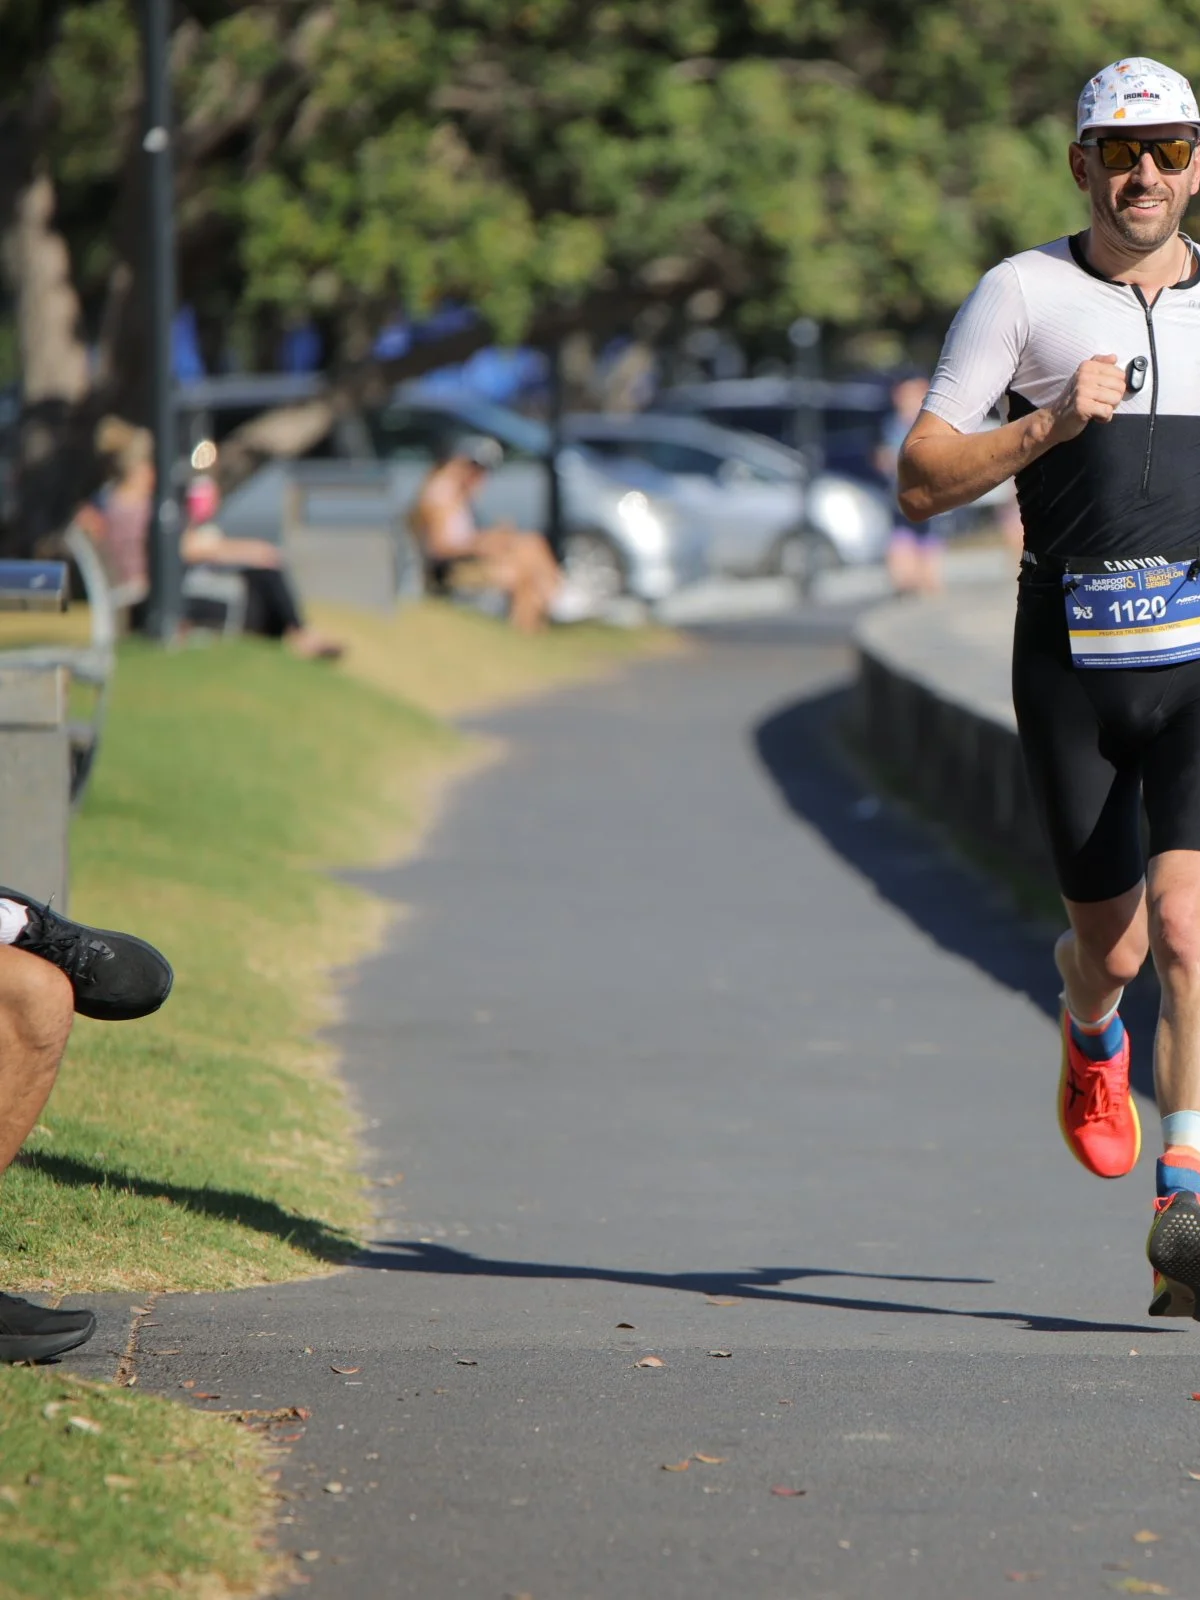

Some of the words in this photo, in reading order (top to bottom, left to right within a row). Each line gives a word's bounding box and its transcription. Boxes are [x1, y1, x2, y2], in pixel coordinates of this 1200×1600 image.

[1123, 89, 1161, 100] IRONMAN
[1103, 555, 1169, 571] CANYON
[1092, 577, 1126, 586] BARFOOT
[1125, 575, 1137, 589] &
[1144, 570, 1184, 583] TRIATHLON
[1083, 584, 1126, 592] THOMPSON
[1145, 579, 1171, 589] SERIES
[1108, 595, 1167, 622] 1120
